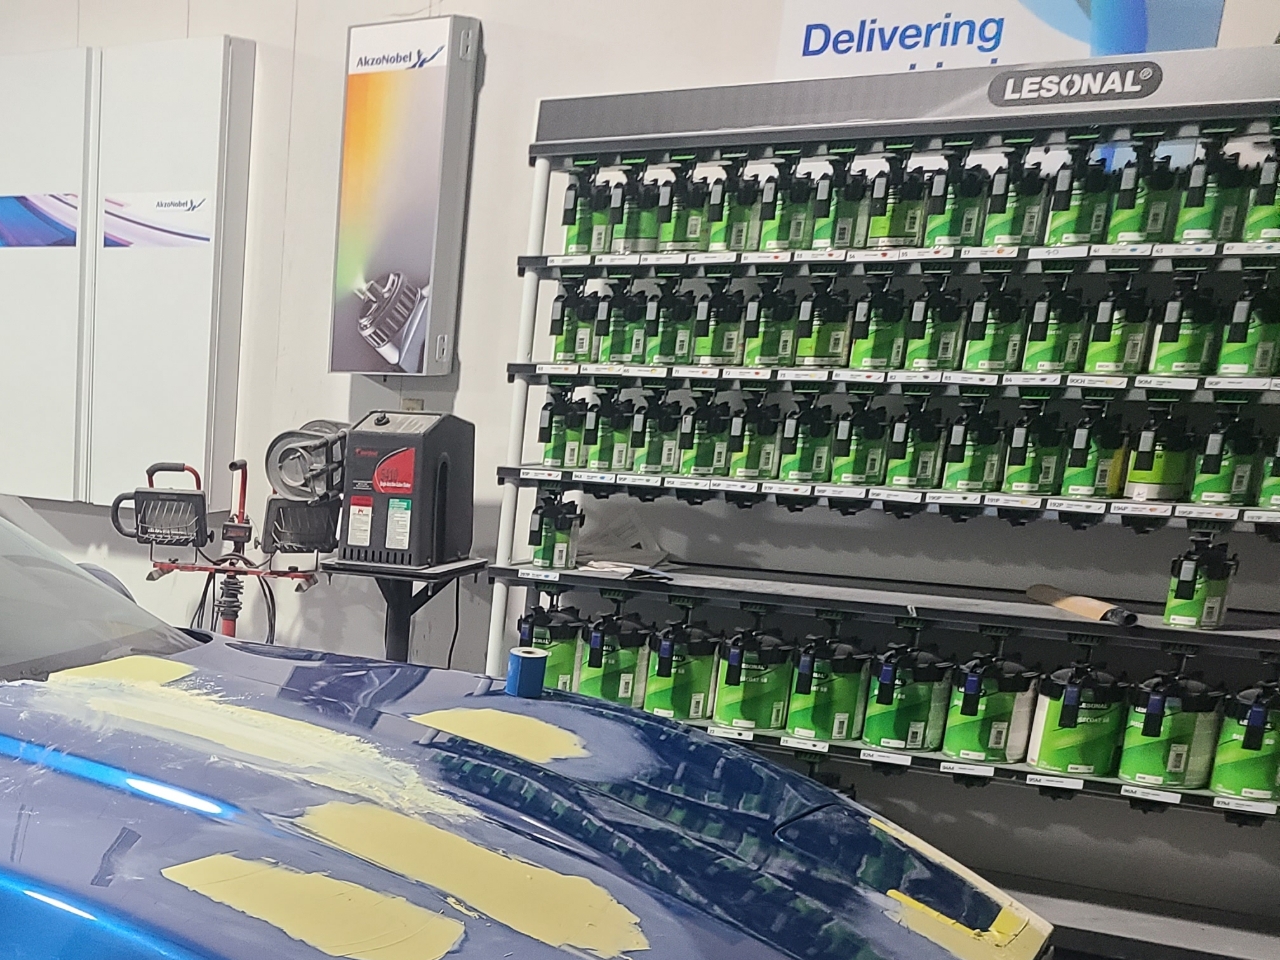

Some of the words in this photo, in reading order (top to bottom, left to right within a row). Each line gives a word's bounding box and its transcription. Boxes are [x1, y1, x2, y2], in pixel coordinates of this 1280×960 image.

[802, 12, 1005, 57] Delivering
[356, 51, 412, 68] AkzoNobel
[156, 200, 188, 208] AkzoNobel
